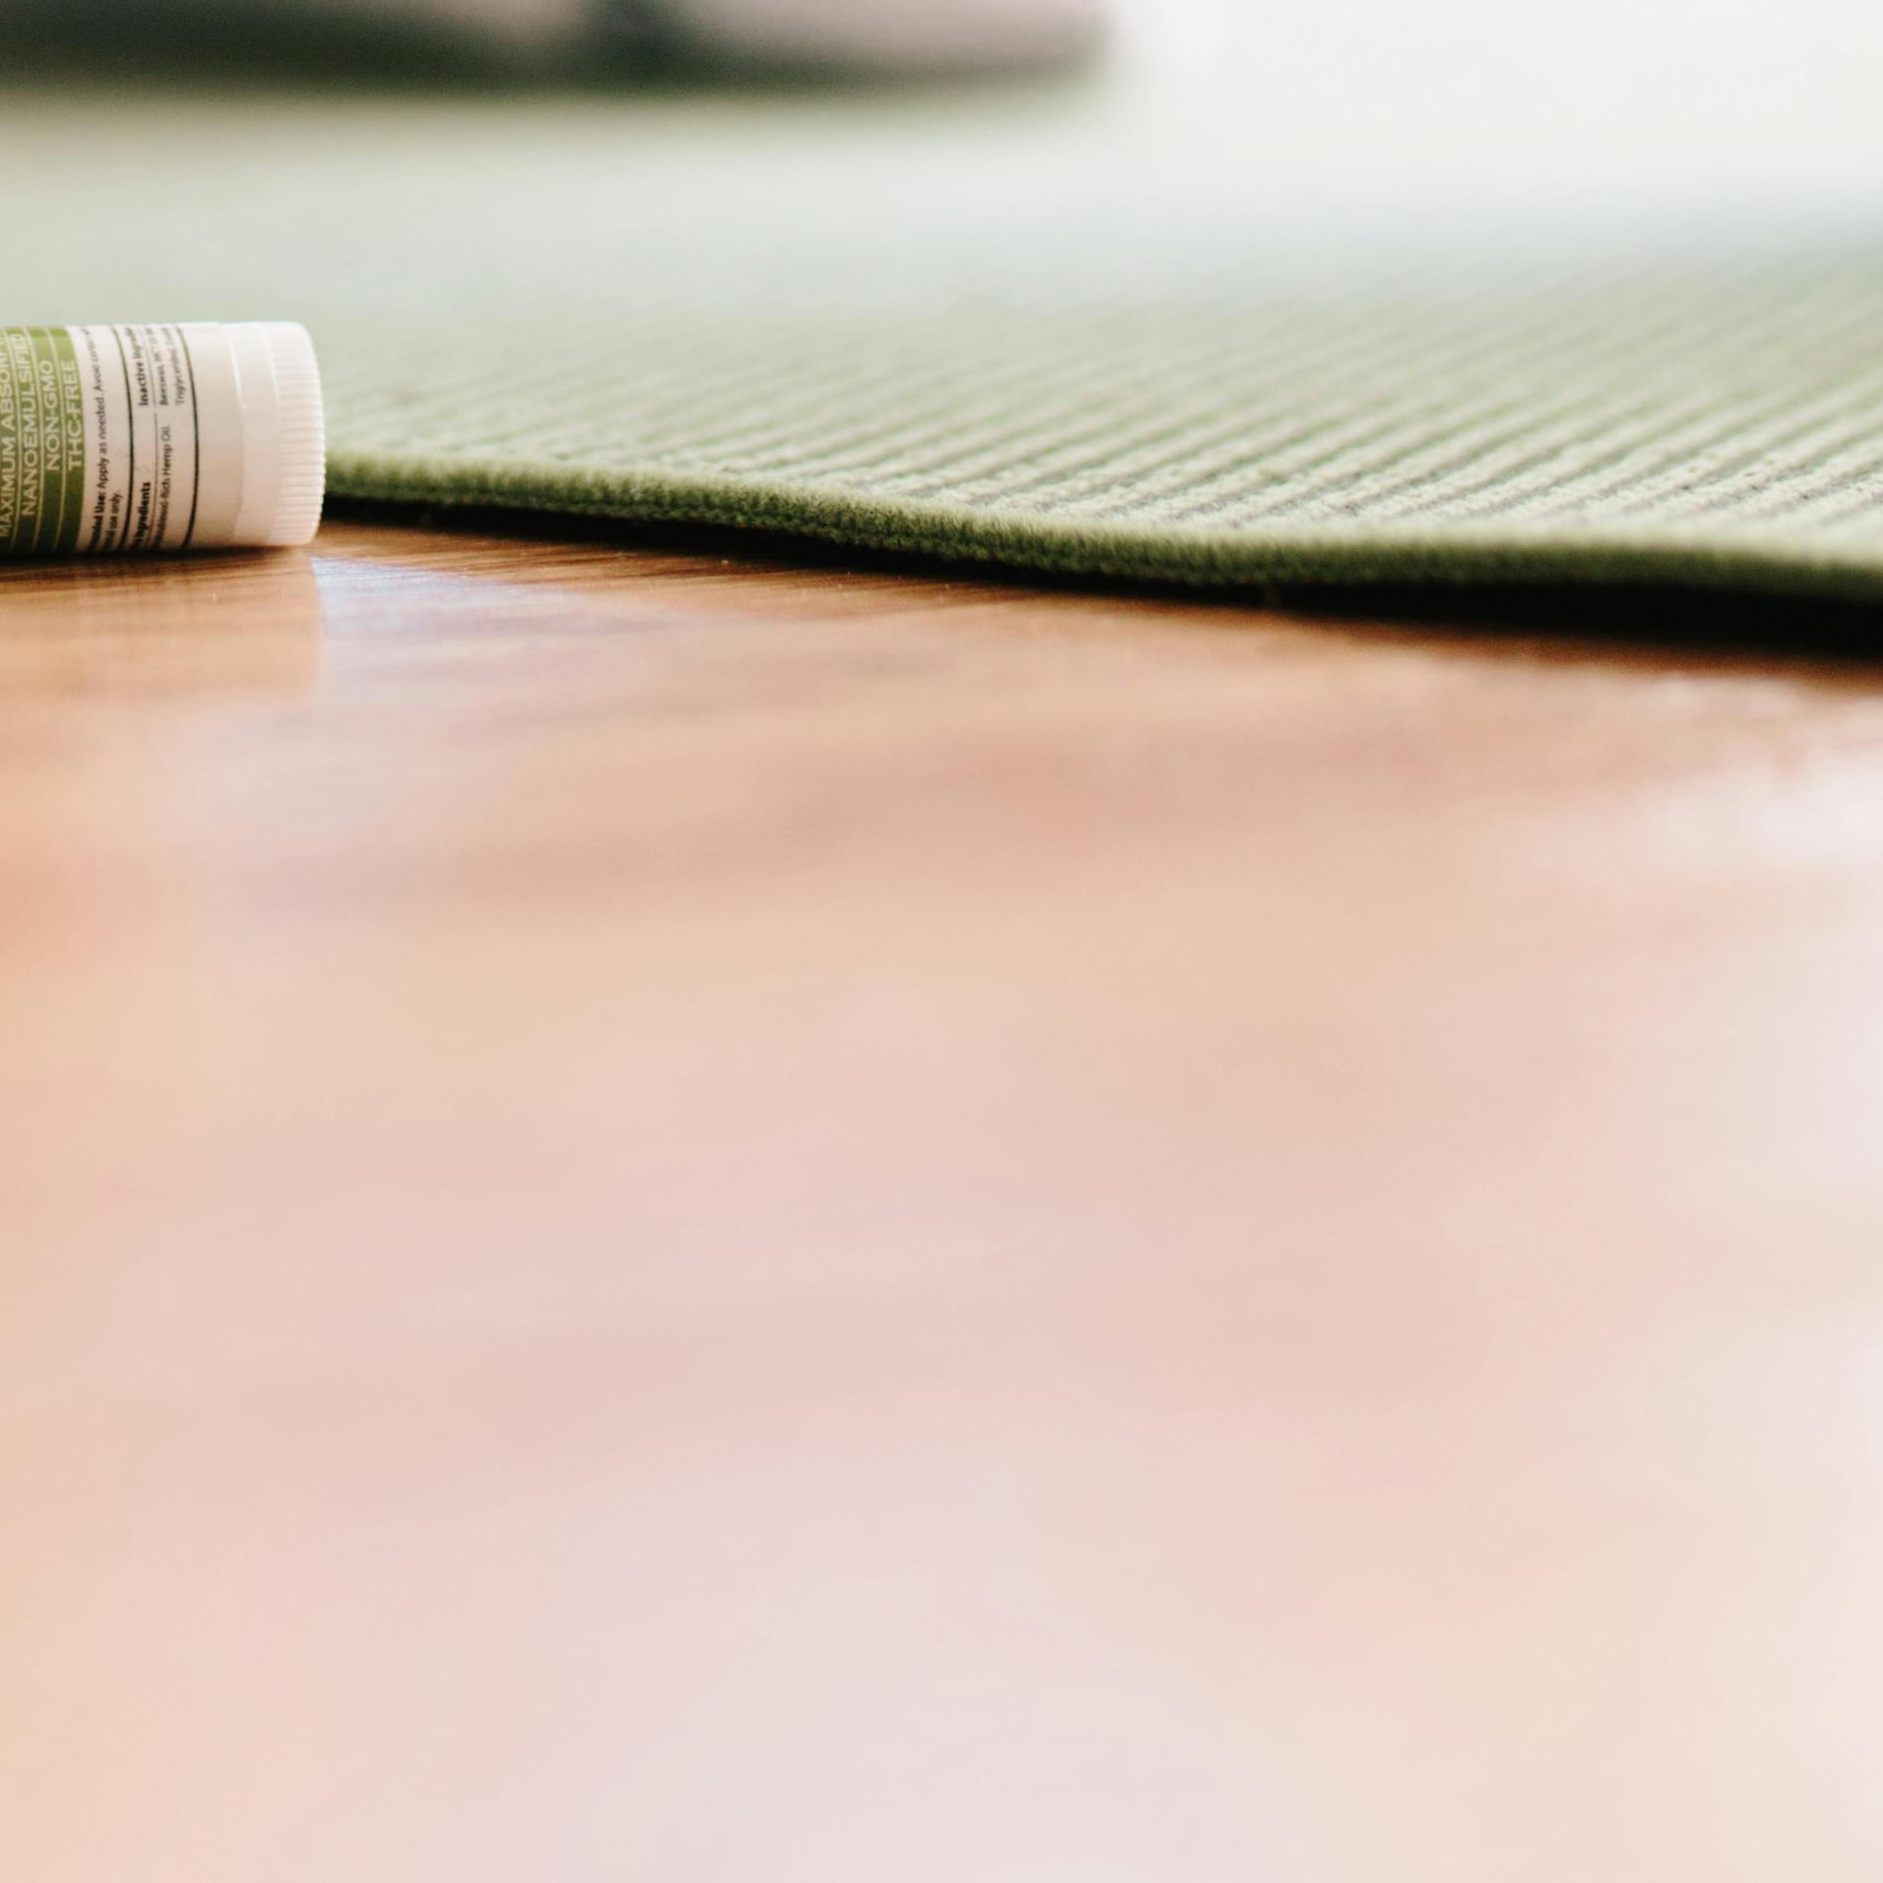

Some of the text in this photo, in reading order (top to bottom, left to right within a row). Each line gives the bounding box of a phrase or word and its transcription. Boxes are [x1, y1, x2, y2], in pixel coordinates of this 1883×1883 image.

[134, 361, 149, 407] Inactive
[10, 333, 38, 516] NANOEMULSIFIED
[39, 360, 61, 471] NON-GMO
[61, 359, 83, 471] THC-FREE
[98, 443, 107, 455] as
[160, 444, 173, 476] Hemp
[95, 457, 110, 490] Apply
